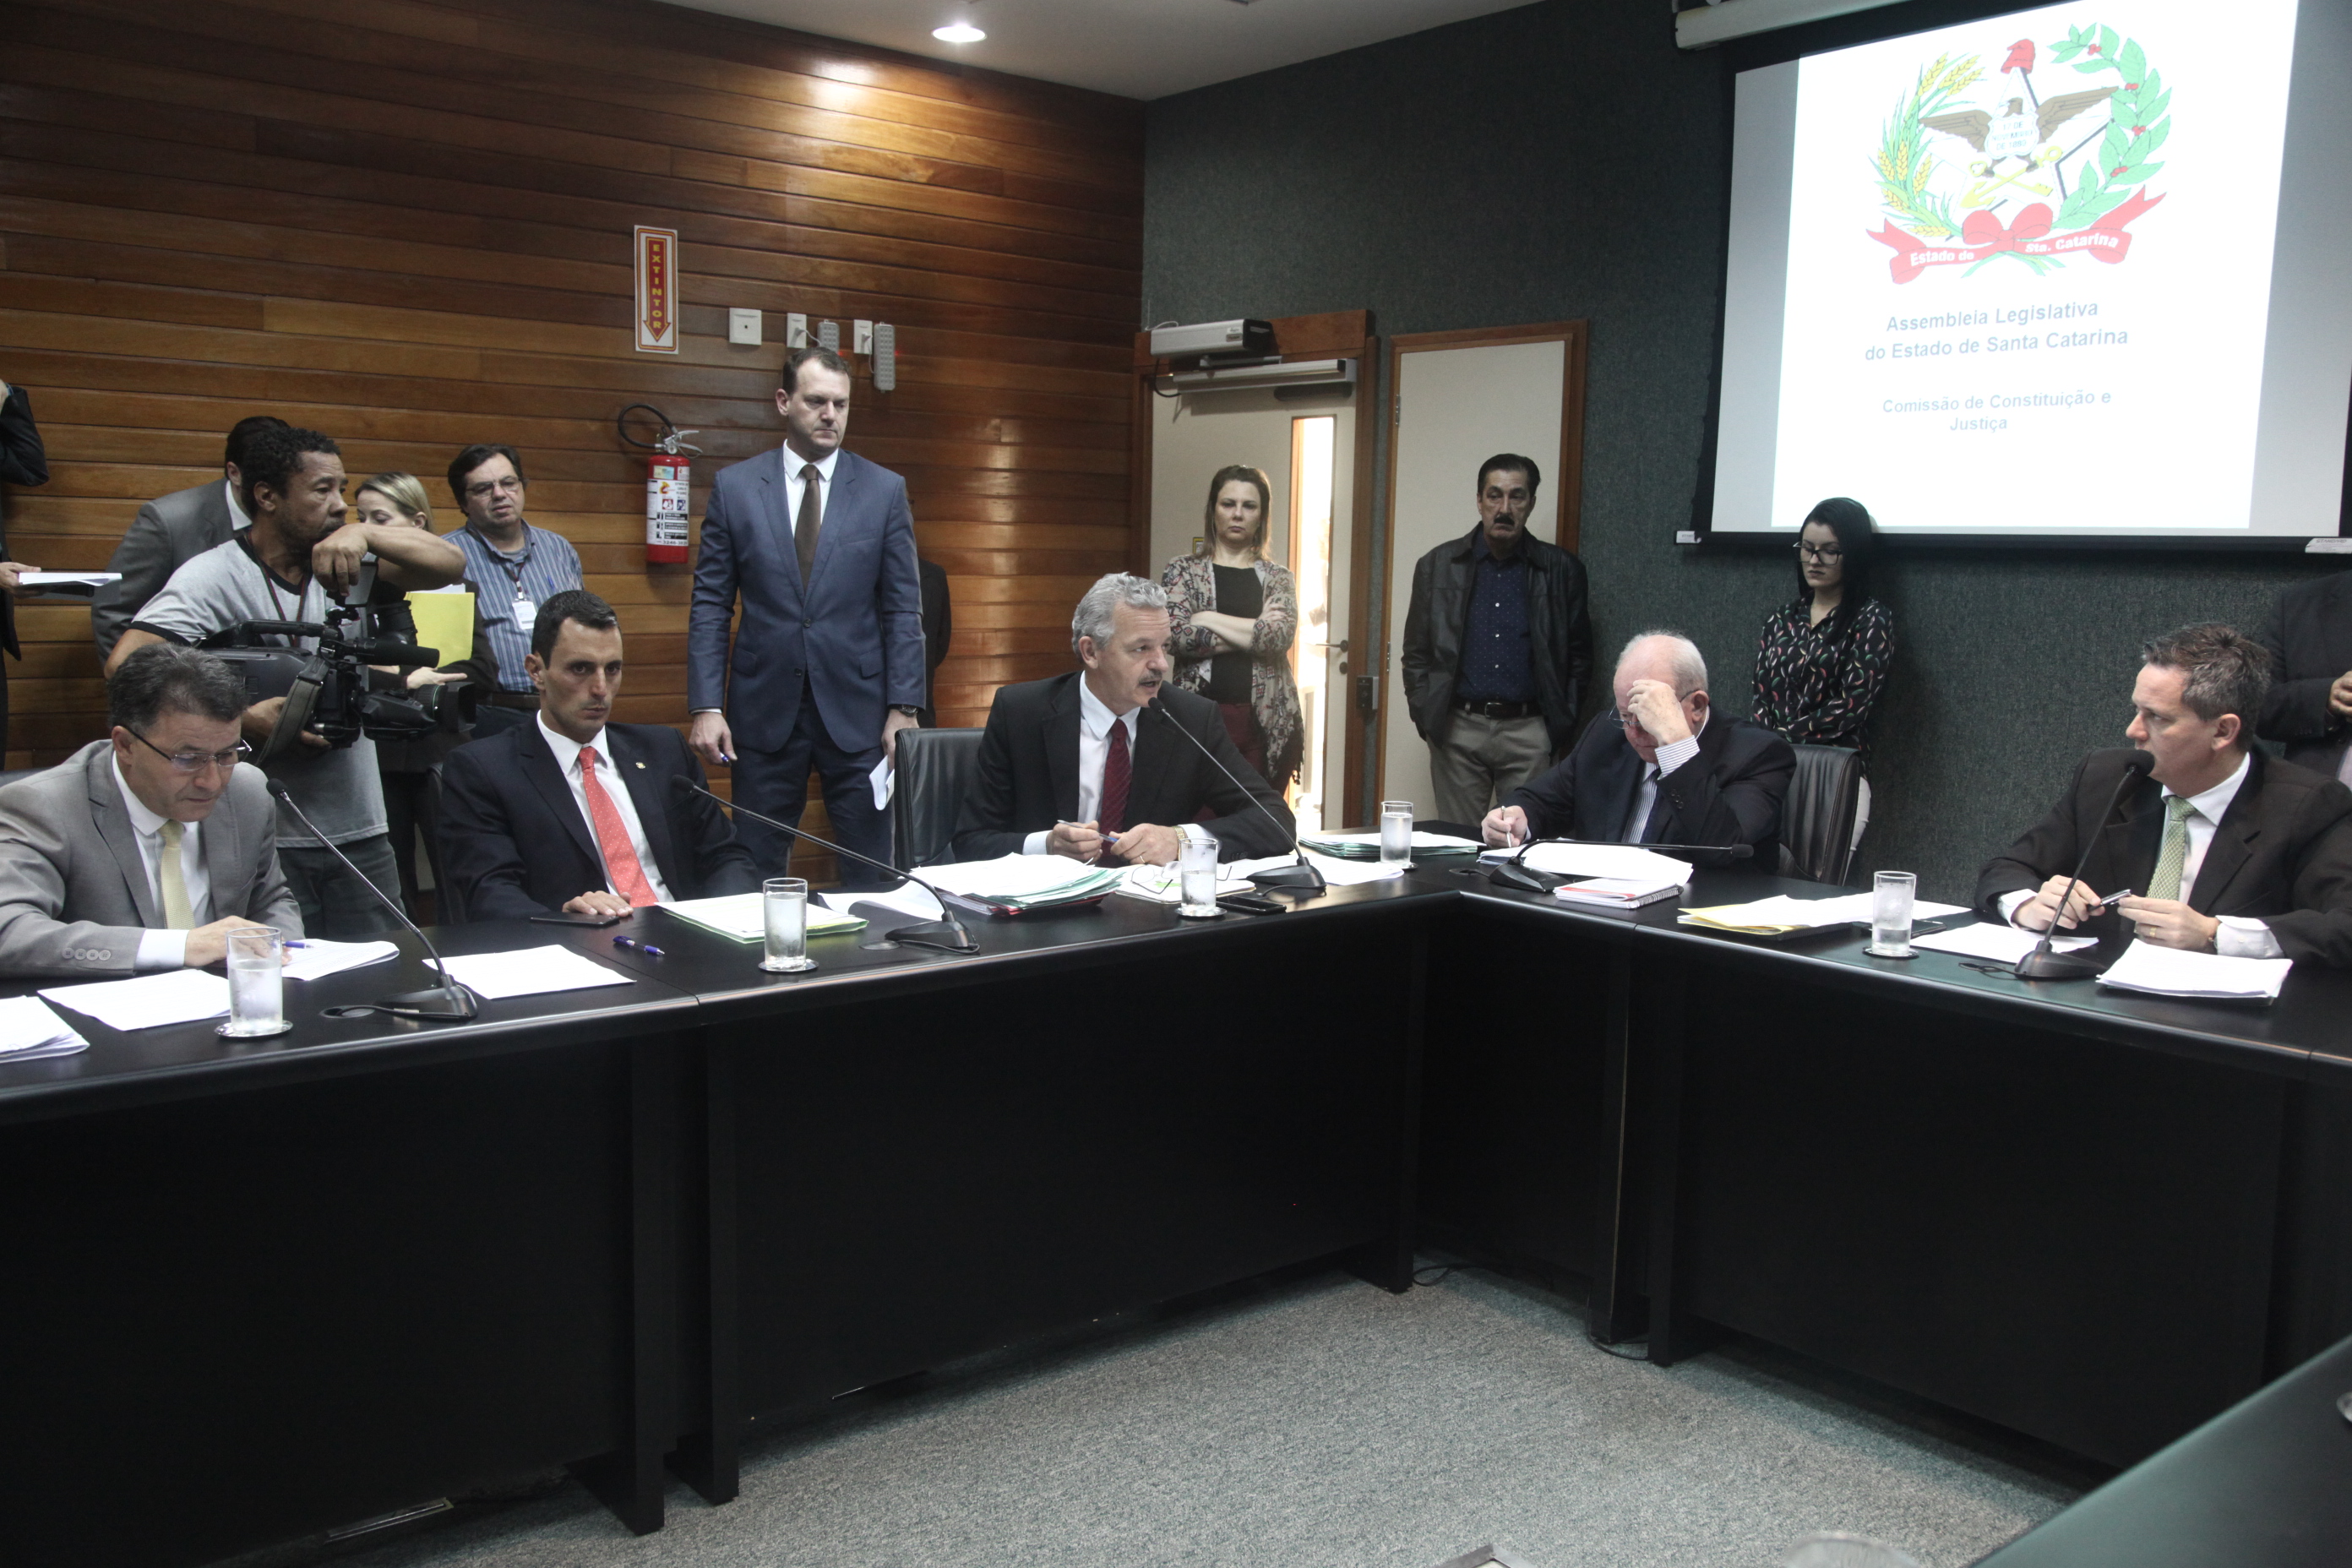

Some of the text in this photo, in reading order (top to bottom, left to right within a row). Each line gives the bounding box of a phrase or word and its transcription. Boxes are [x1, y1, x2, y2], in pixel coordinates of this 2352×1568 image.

[1996, 142, 2006, 150] DE
[2025, 233, 2119, 253] Sta. Catarina
[1910, 249, 1974, 266] Estado de
[652, 244, 662, 329] EXTINTOR
[1886, 302, 2099, 332] Assembleia Legislativa
[1865, 329, 2128, 361] do Estado de Santa Catarina
[1882, 389, 2111, 413] Comissão de Constituição e
[1950, 416, 2008, 433] Justiça
